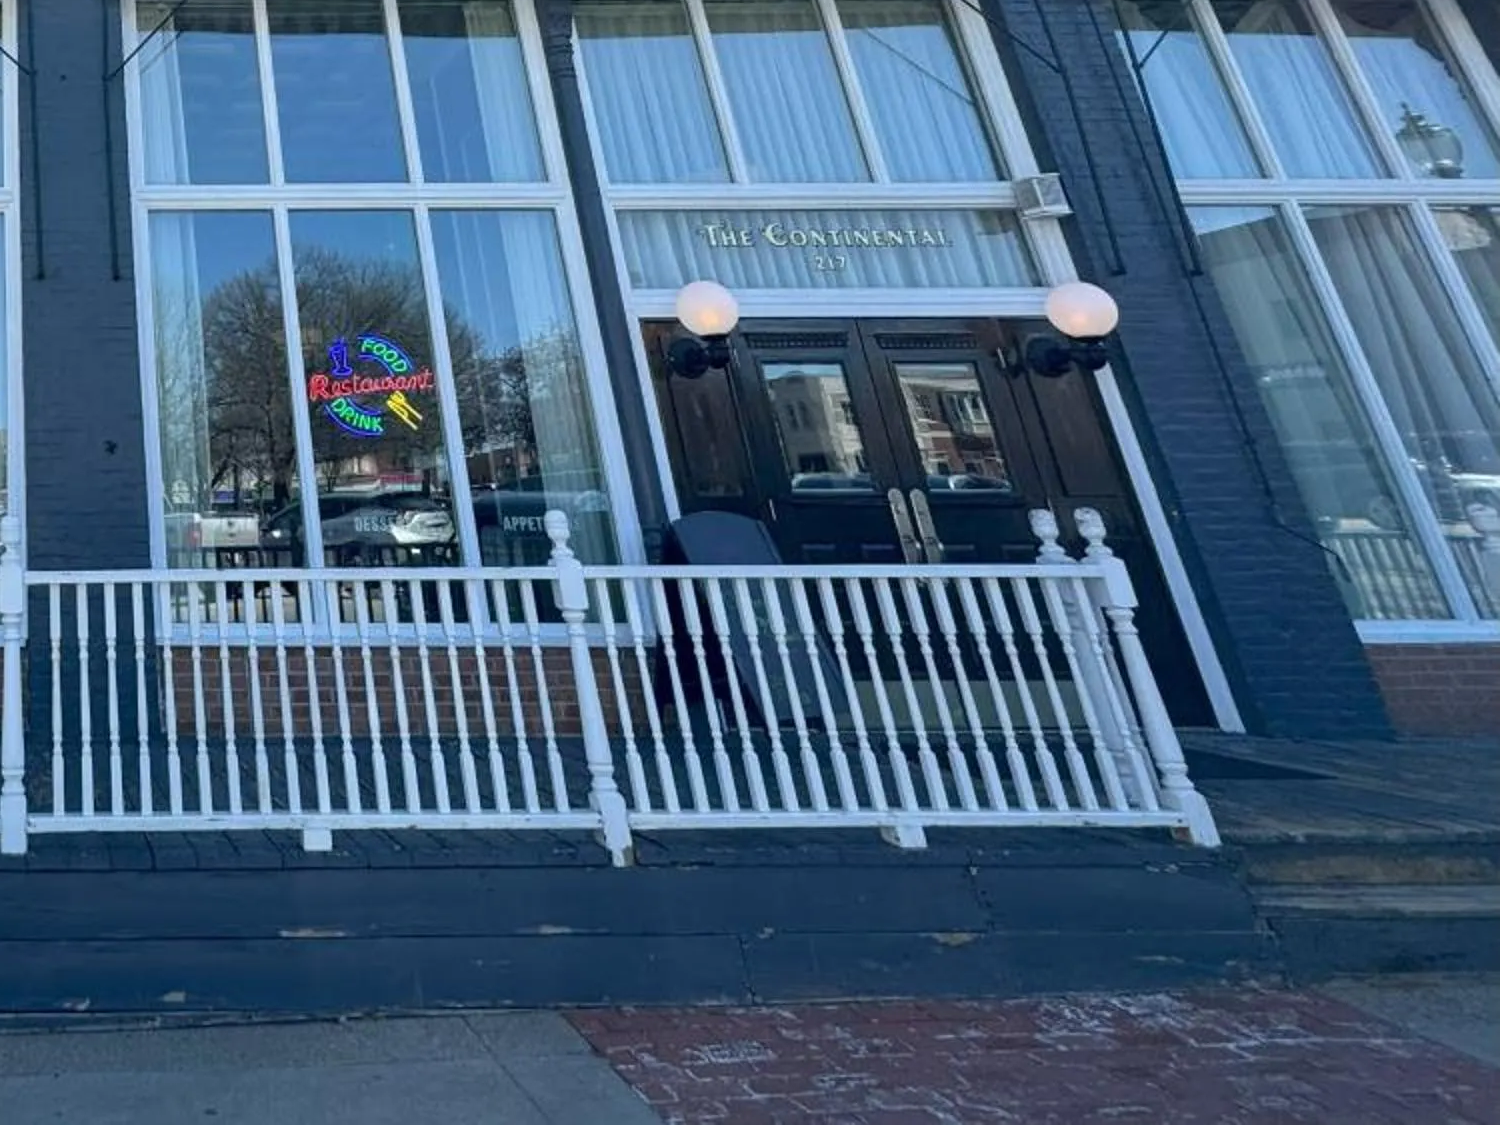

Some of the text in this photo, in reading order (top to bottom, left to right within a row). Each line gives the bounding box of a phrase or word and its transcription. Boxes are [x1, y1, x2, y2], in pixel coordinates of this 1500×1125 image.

[815, 256, 845, 270] 217
[360, 338, 407, 373] FOOD
[309, 366, 433, 402] Restaurant
[330, 397, 384, 433] DRINK
